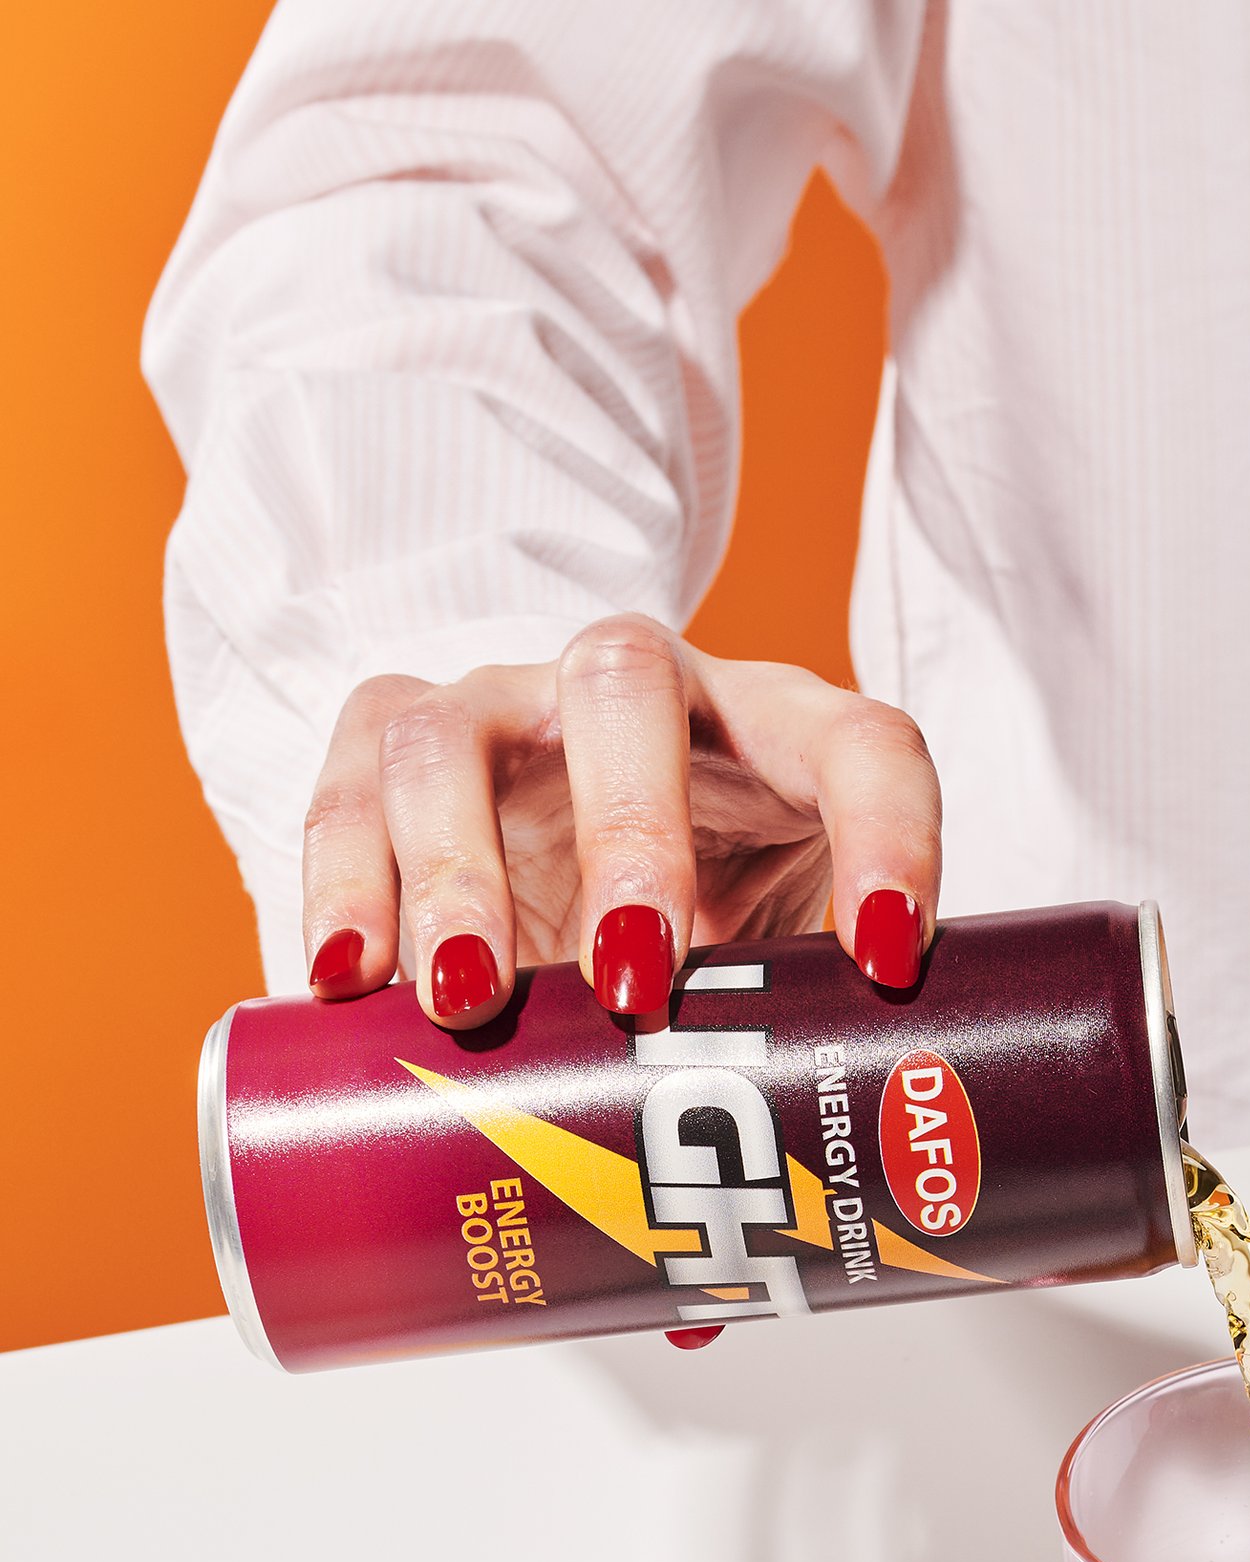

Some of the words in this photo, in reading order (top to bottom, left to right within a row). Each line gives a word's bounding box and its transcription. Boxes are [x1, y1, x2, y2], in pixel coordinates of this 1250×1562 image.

[813, 1045, 860, 1188] ENERGY
[901, 1067, 962, 1230] DAFOS
[456, 1193, 509, 1304] BOOST
[490, 1177, 547, 1306] ENERGY
[832, 1197, 877, 1284] DRINK
